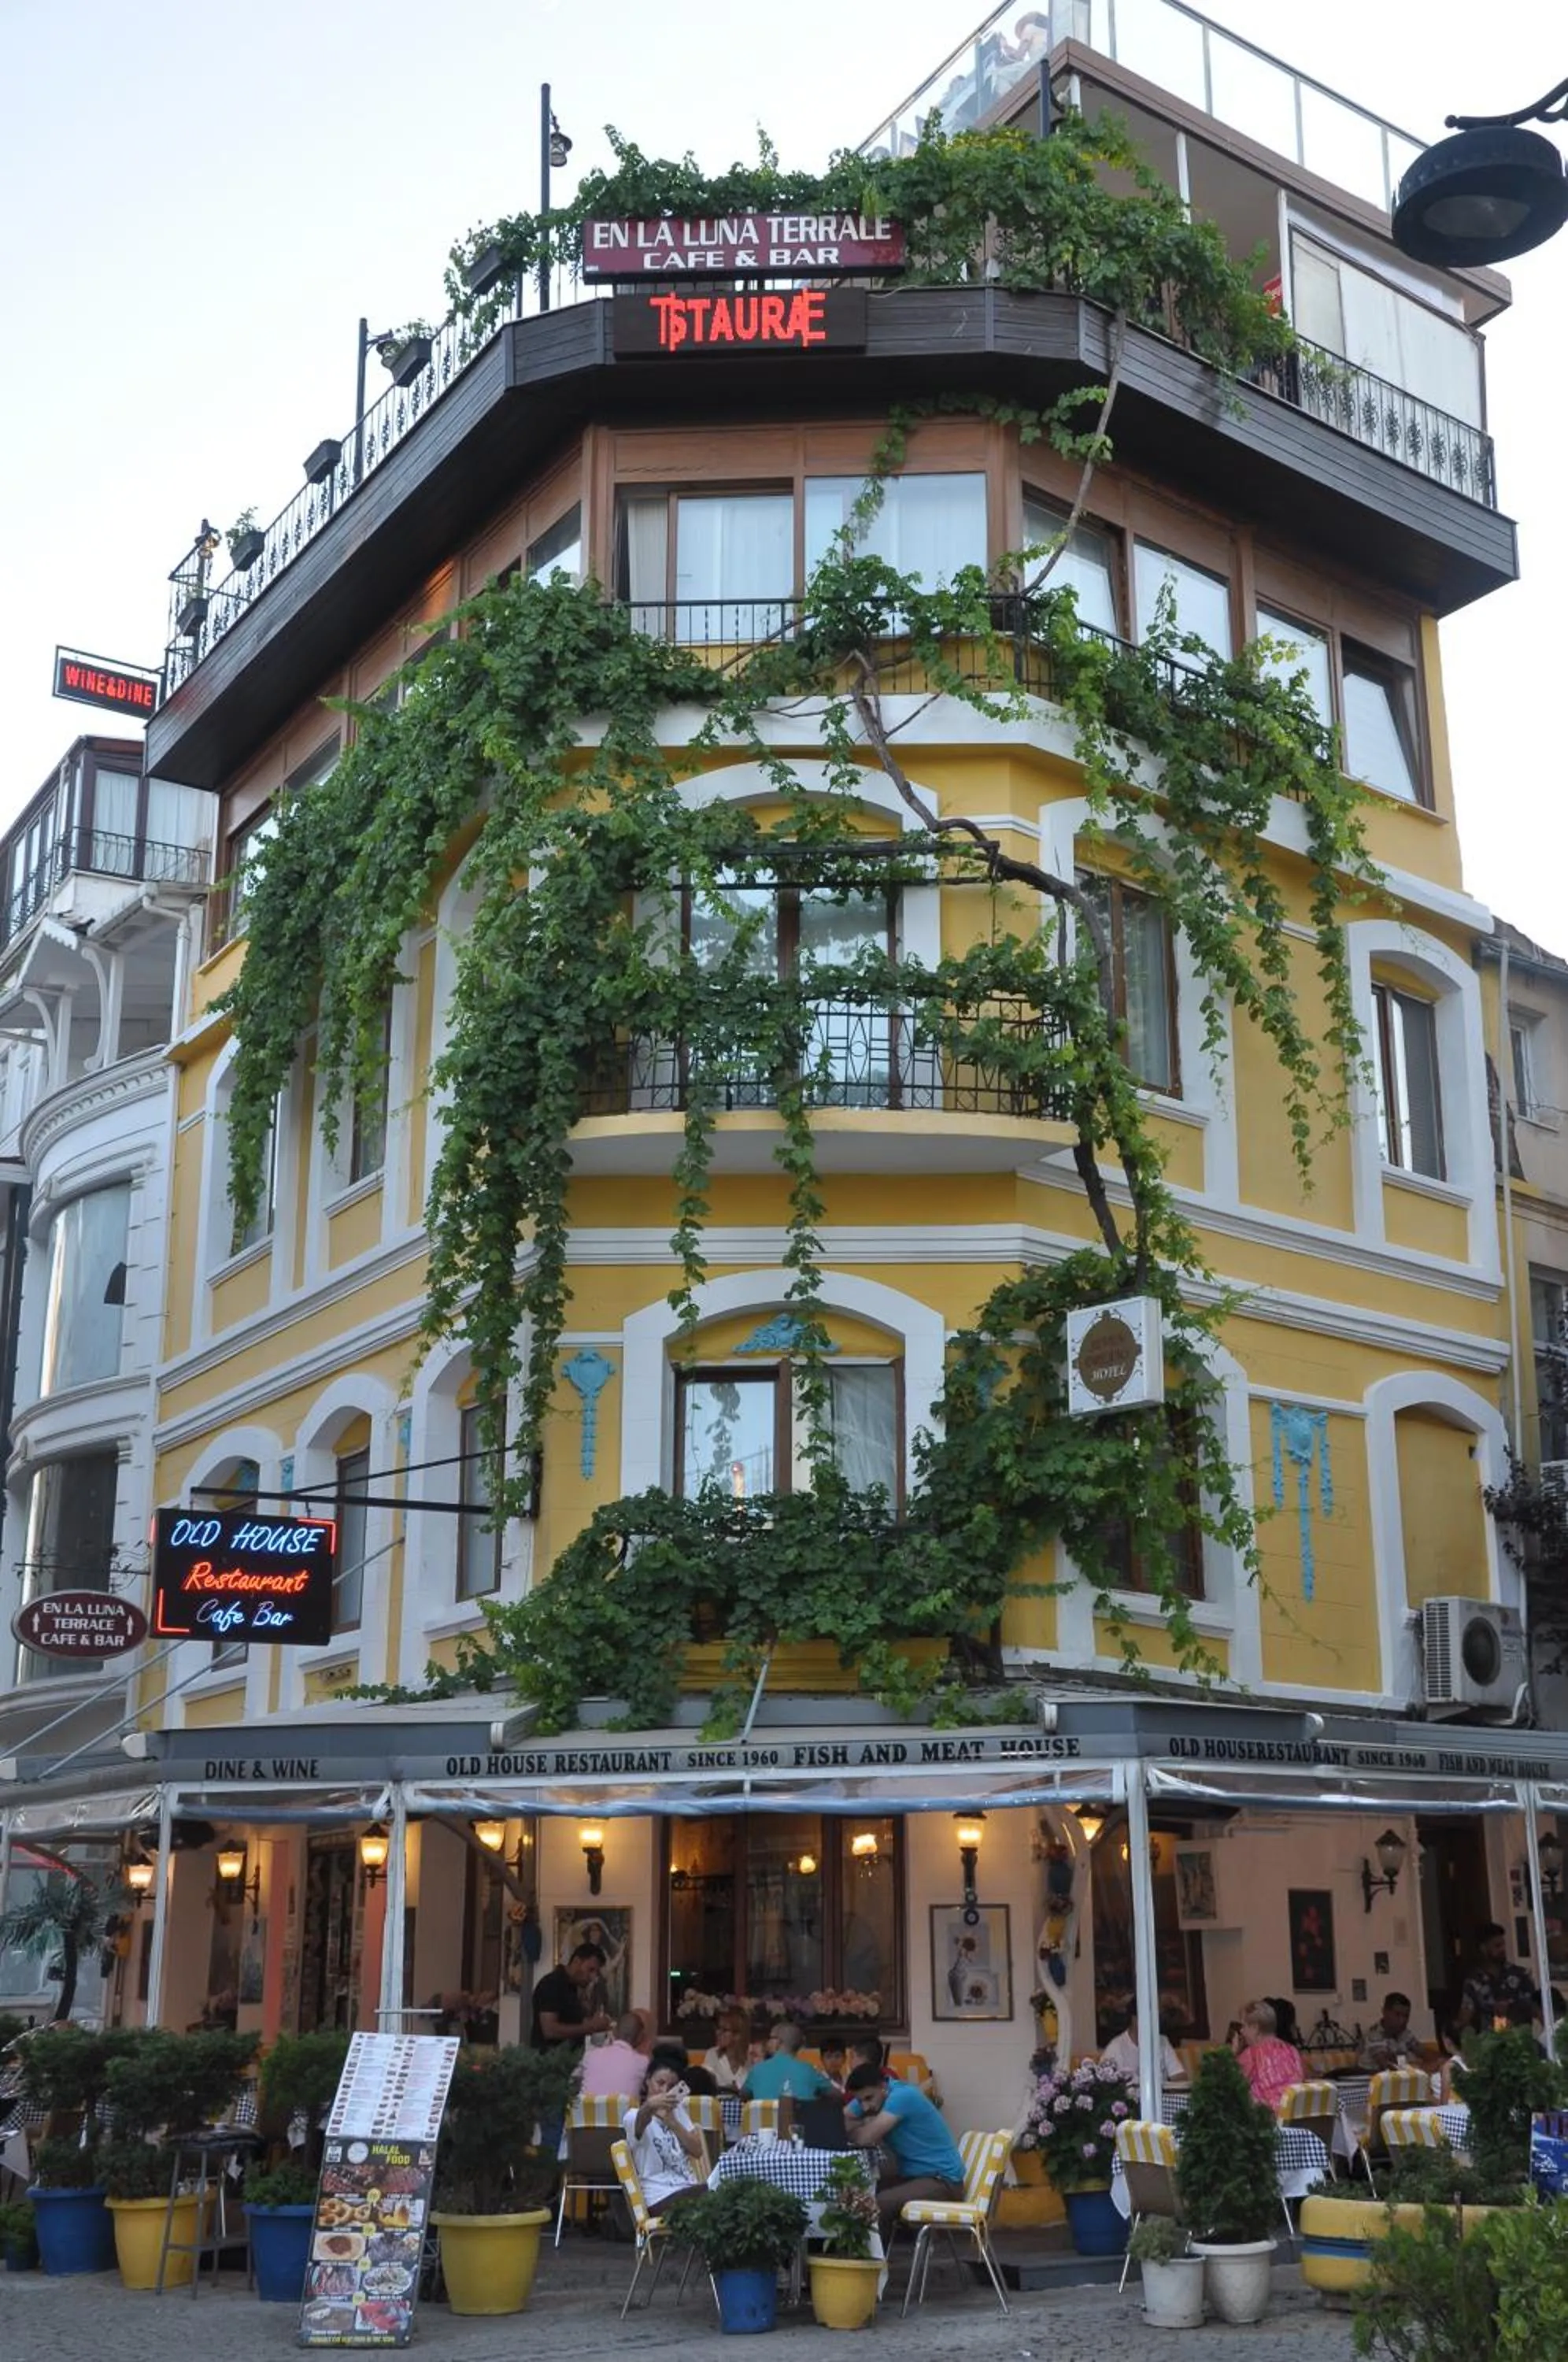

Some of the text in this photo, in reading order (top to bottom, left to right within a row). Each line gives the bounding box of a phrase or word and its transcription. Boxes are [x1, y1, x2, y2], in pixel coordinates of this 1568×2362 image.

[593, 222, 629, 249] EN
[637, 220, 675, 247] LA
[682, 217, 760, 246] LUNA
[643, 247, 839, 269] CAFE & BAR
[171, 1519, 326, 1553] OLD HOUSE
[183, 1561, 309, 1592] Restaurant
[43, 1602, 125, 1616] EN LA LUNA
[196, 1598, 294, 1632] Cafe Bar
[52, 1617, 115, 1631] TERRACE
[40, 1633, 125, 1647] CAFE & BAR
[793, 1738, 1081, 1765] FISH AND MEAT HOUSE
[1169, 1737, 1200, 1757] OLD
[205, 1759, 320, 1779] DINE & WINE
[446, 1752, 672, 1776] OLD HOUSE RESTAURANT
[687, 1750, 778, 1768] SINCE 1960
[1357, 1751, 1395, 1767] SINCE
[1439, 1753, 1463, 1772] FISH
[1466, 1754, 1487, 1775] AND
[372, 2145, 401, 2155] HALAL
[385, 2154, 411, 2165] FOOD
